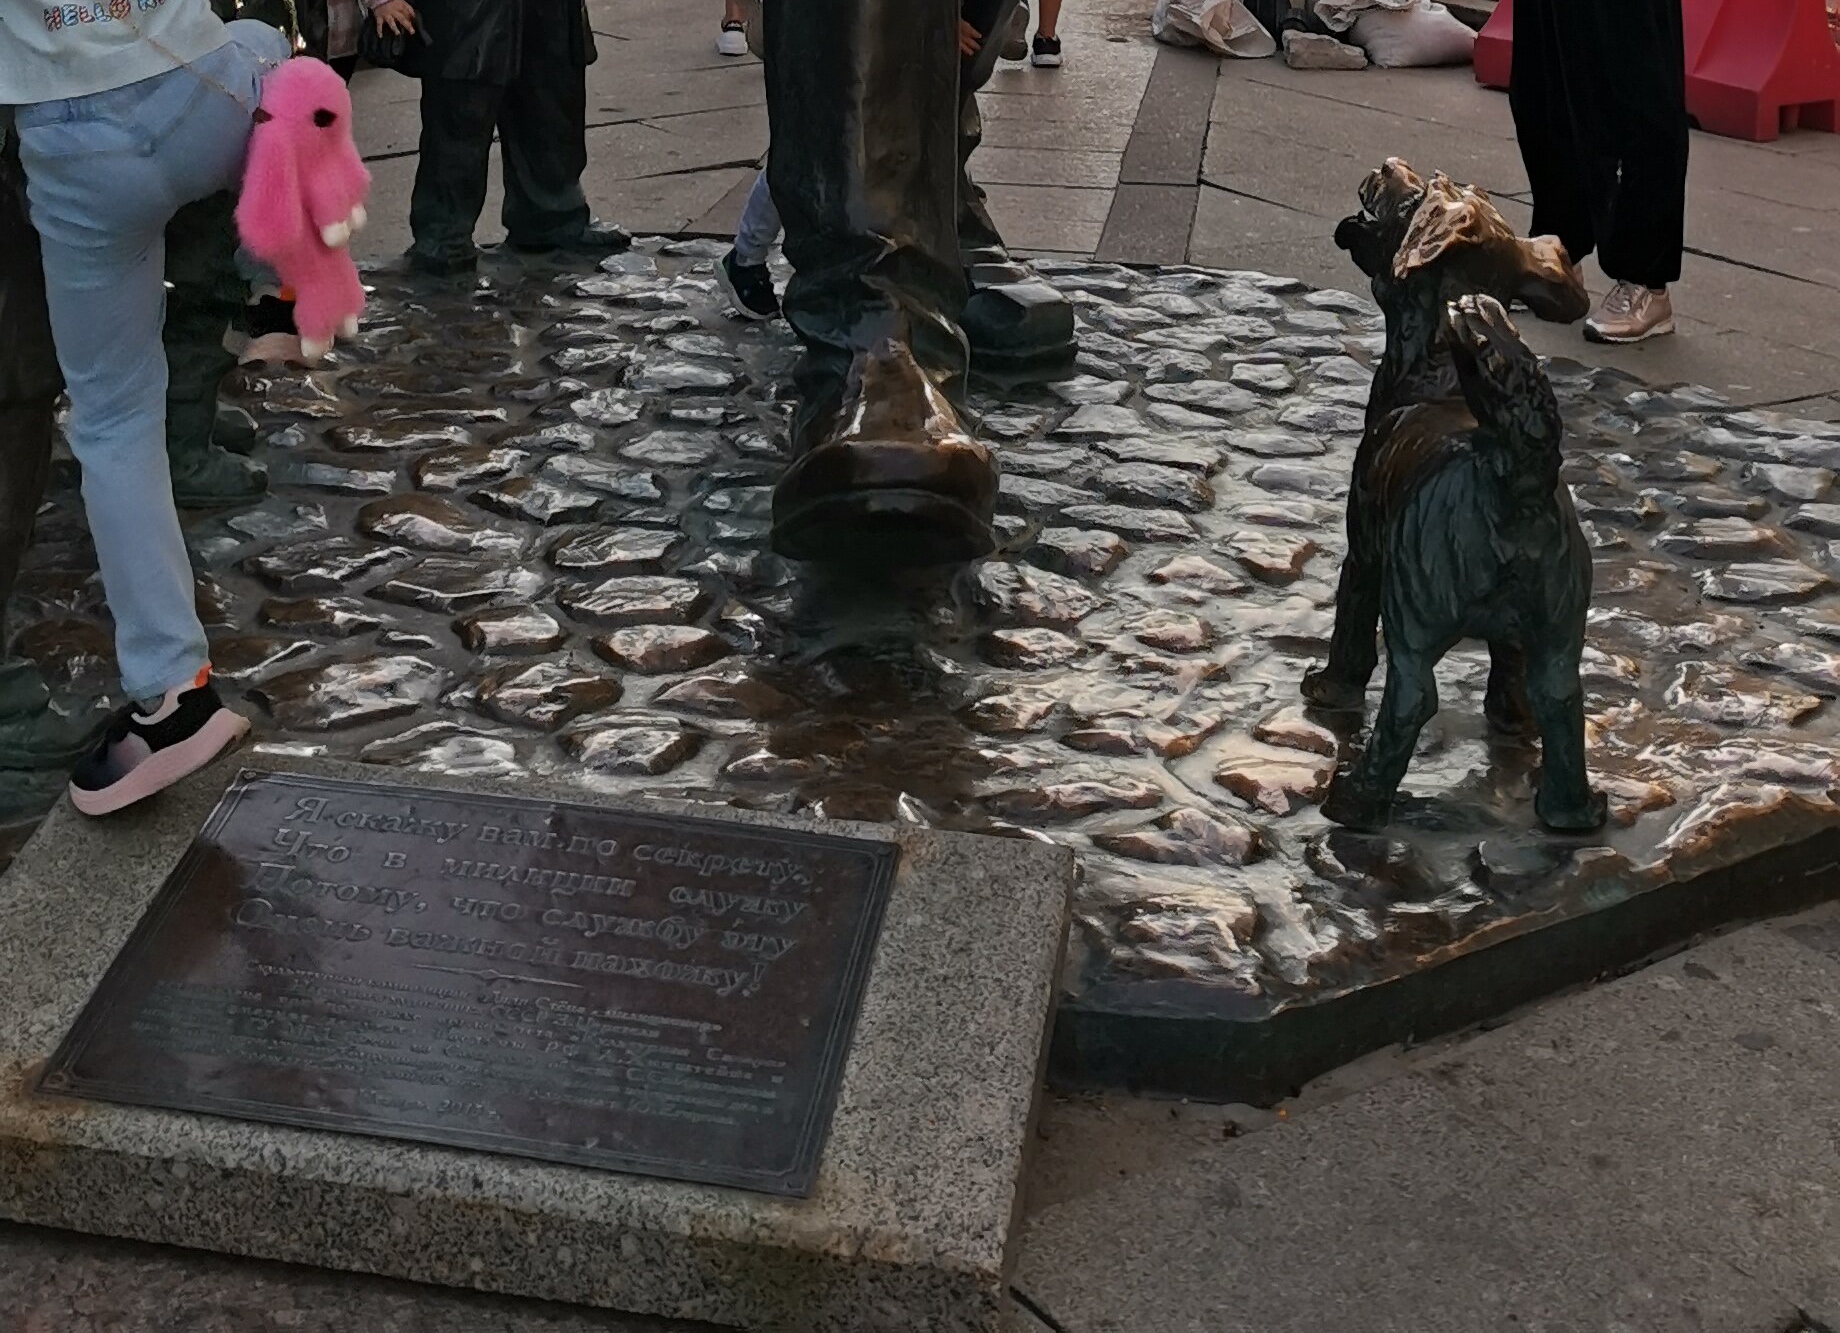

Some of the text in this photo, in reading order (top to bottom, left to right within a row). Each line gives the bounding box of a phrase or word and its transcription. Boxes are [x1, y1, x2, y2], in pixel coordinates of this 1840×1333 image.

[284, 796, 331, 823] Я
[335, 810, 470, 844] скажу
[477, 825, 558, 850] вам
[566, 835, 619, 858] по
[254, 862, 428, 914] Потому,
[452, 896, 525, 921] что
[542, 908, 704, 950] службу
[273, 827, 809, 924] Что в милиции служу
[385, 927, 561, 966] важной
